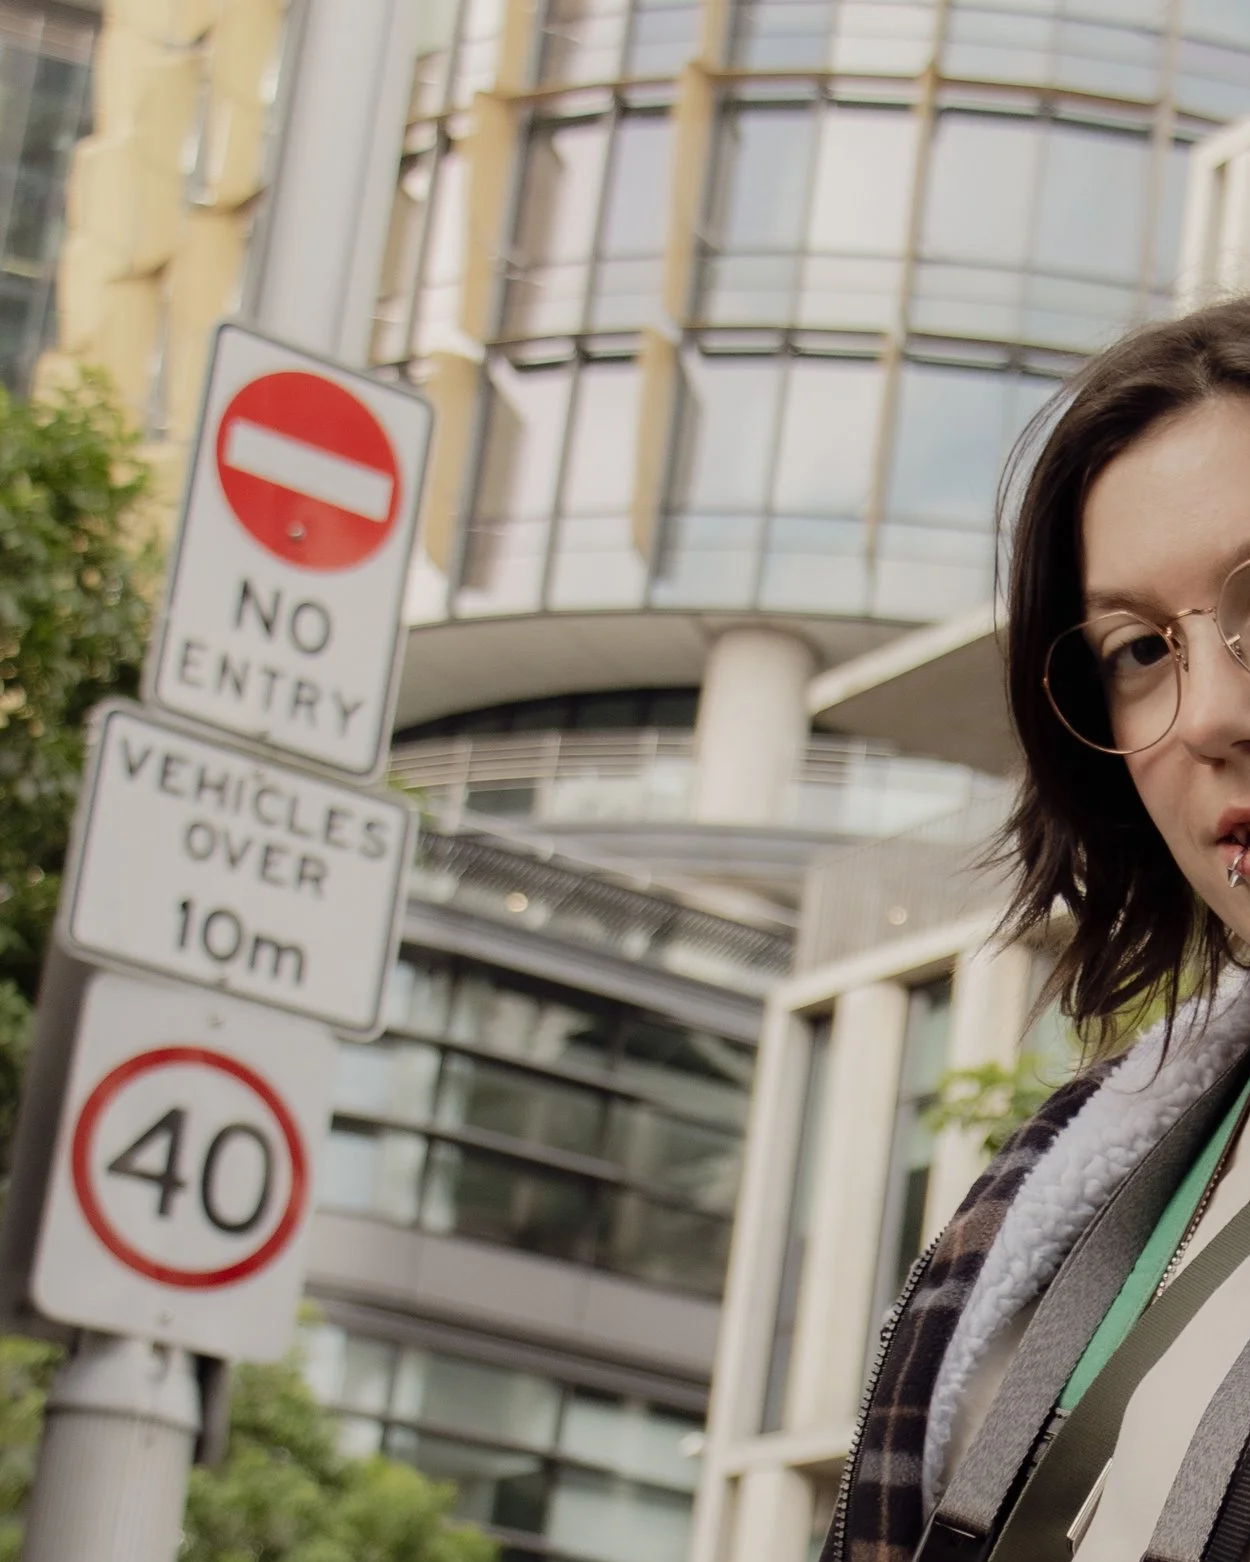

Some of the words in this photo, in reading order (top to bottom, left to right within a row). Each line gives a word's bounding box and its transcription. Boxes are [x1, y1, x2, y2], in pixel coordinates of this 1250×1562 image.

[235, 579, 332, 655] NO
[179, 641, 363, 737] ENTRY
[119, 738, 390, 861] VEHICLES
[186, 821, 331, 897] OVER
[177, 900, 308, 987] 10m
[107, 1107, 275, 1236] 40
